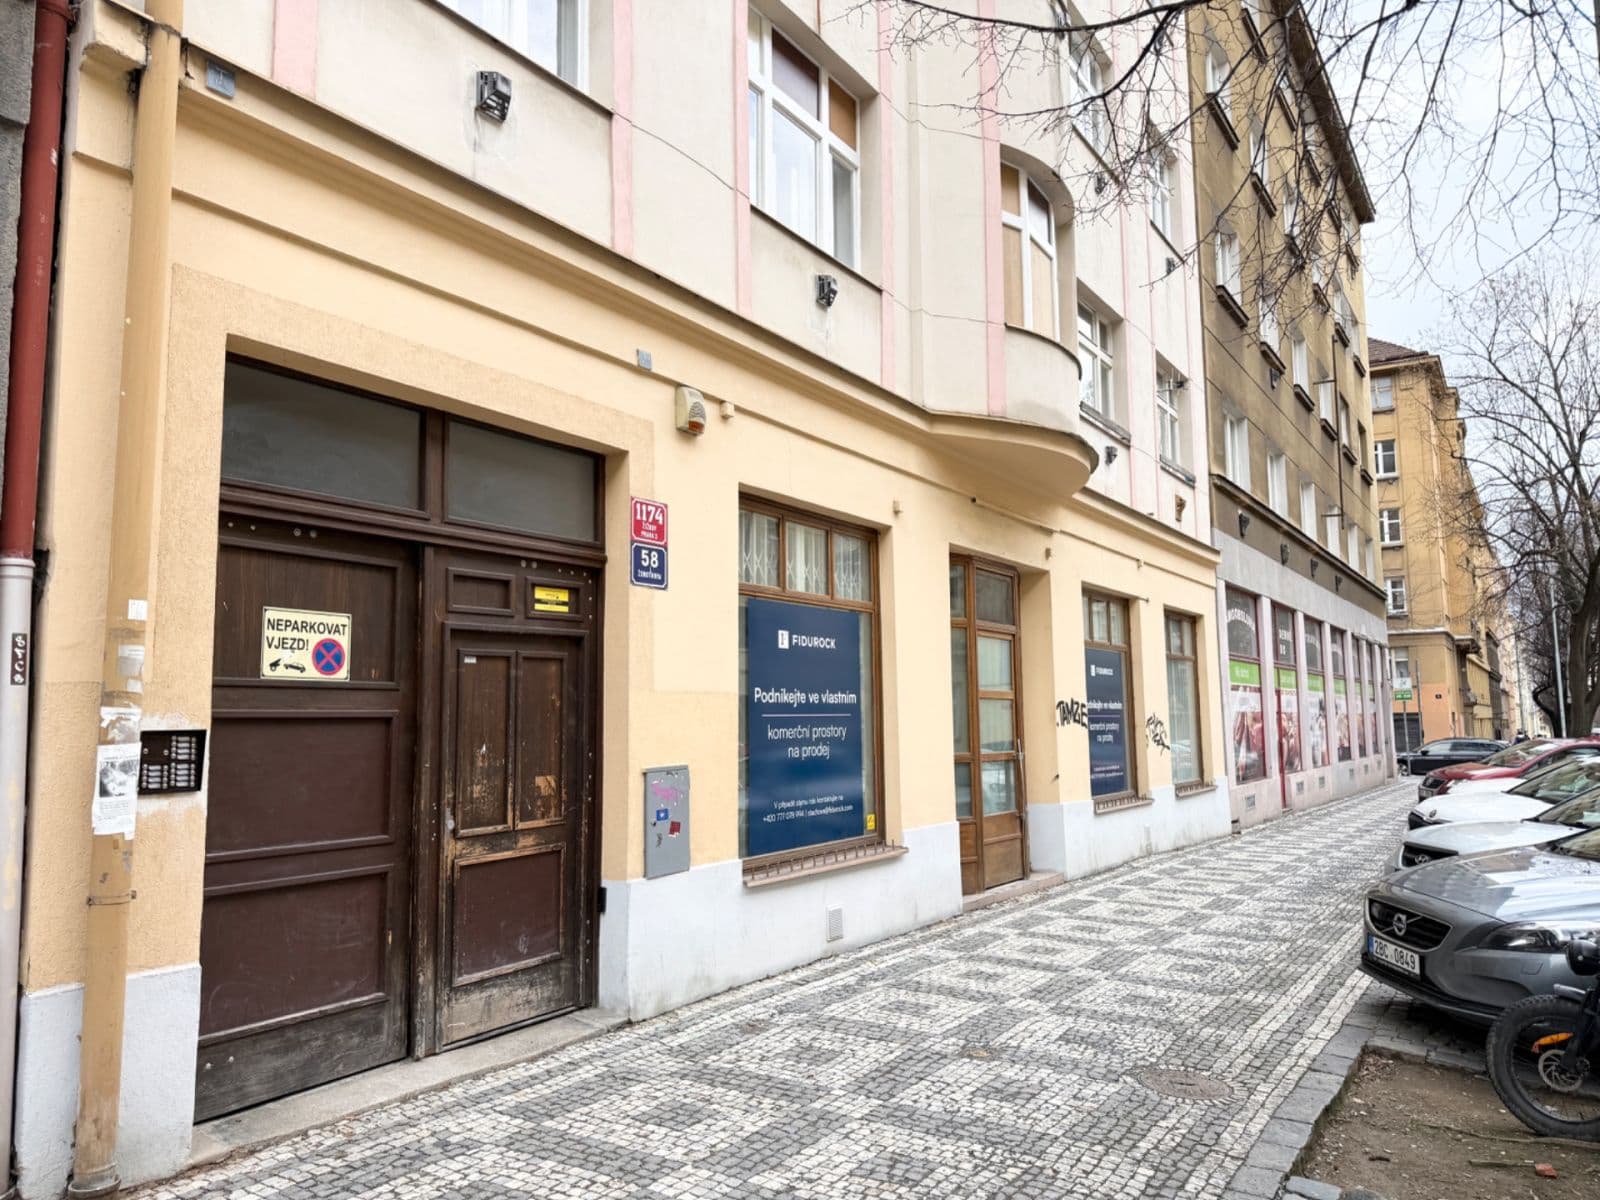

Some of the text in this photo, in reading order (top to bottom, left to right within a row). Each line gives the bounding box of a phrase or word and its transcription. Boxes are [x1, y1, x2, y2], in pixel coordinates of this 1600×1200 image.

[635, 503, 664, 525] 1174
[641, 549, 659, 568] 58
[266, 618, 347, 636] NEPARKOVAT
[266, 636, 309, 651] VJEZD!
[792, 634, 836, 649] FIDUROCK
[754, 687, 857, 708] Podnikejte ve vlastním
[767, 724, 847, 741] komerční prostory
[787, 742, 830, 760] na prodej
[1394, 947, 1416, 970] 0849
